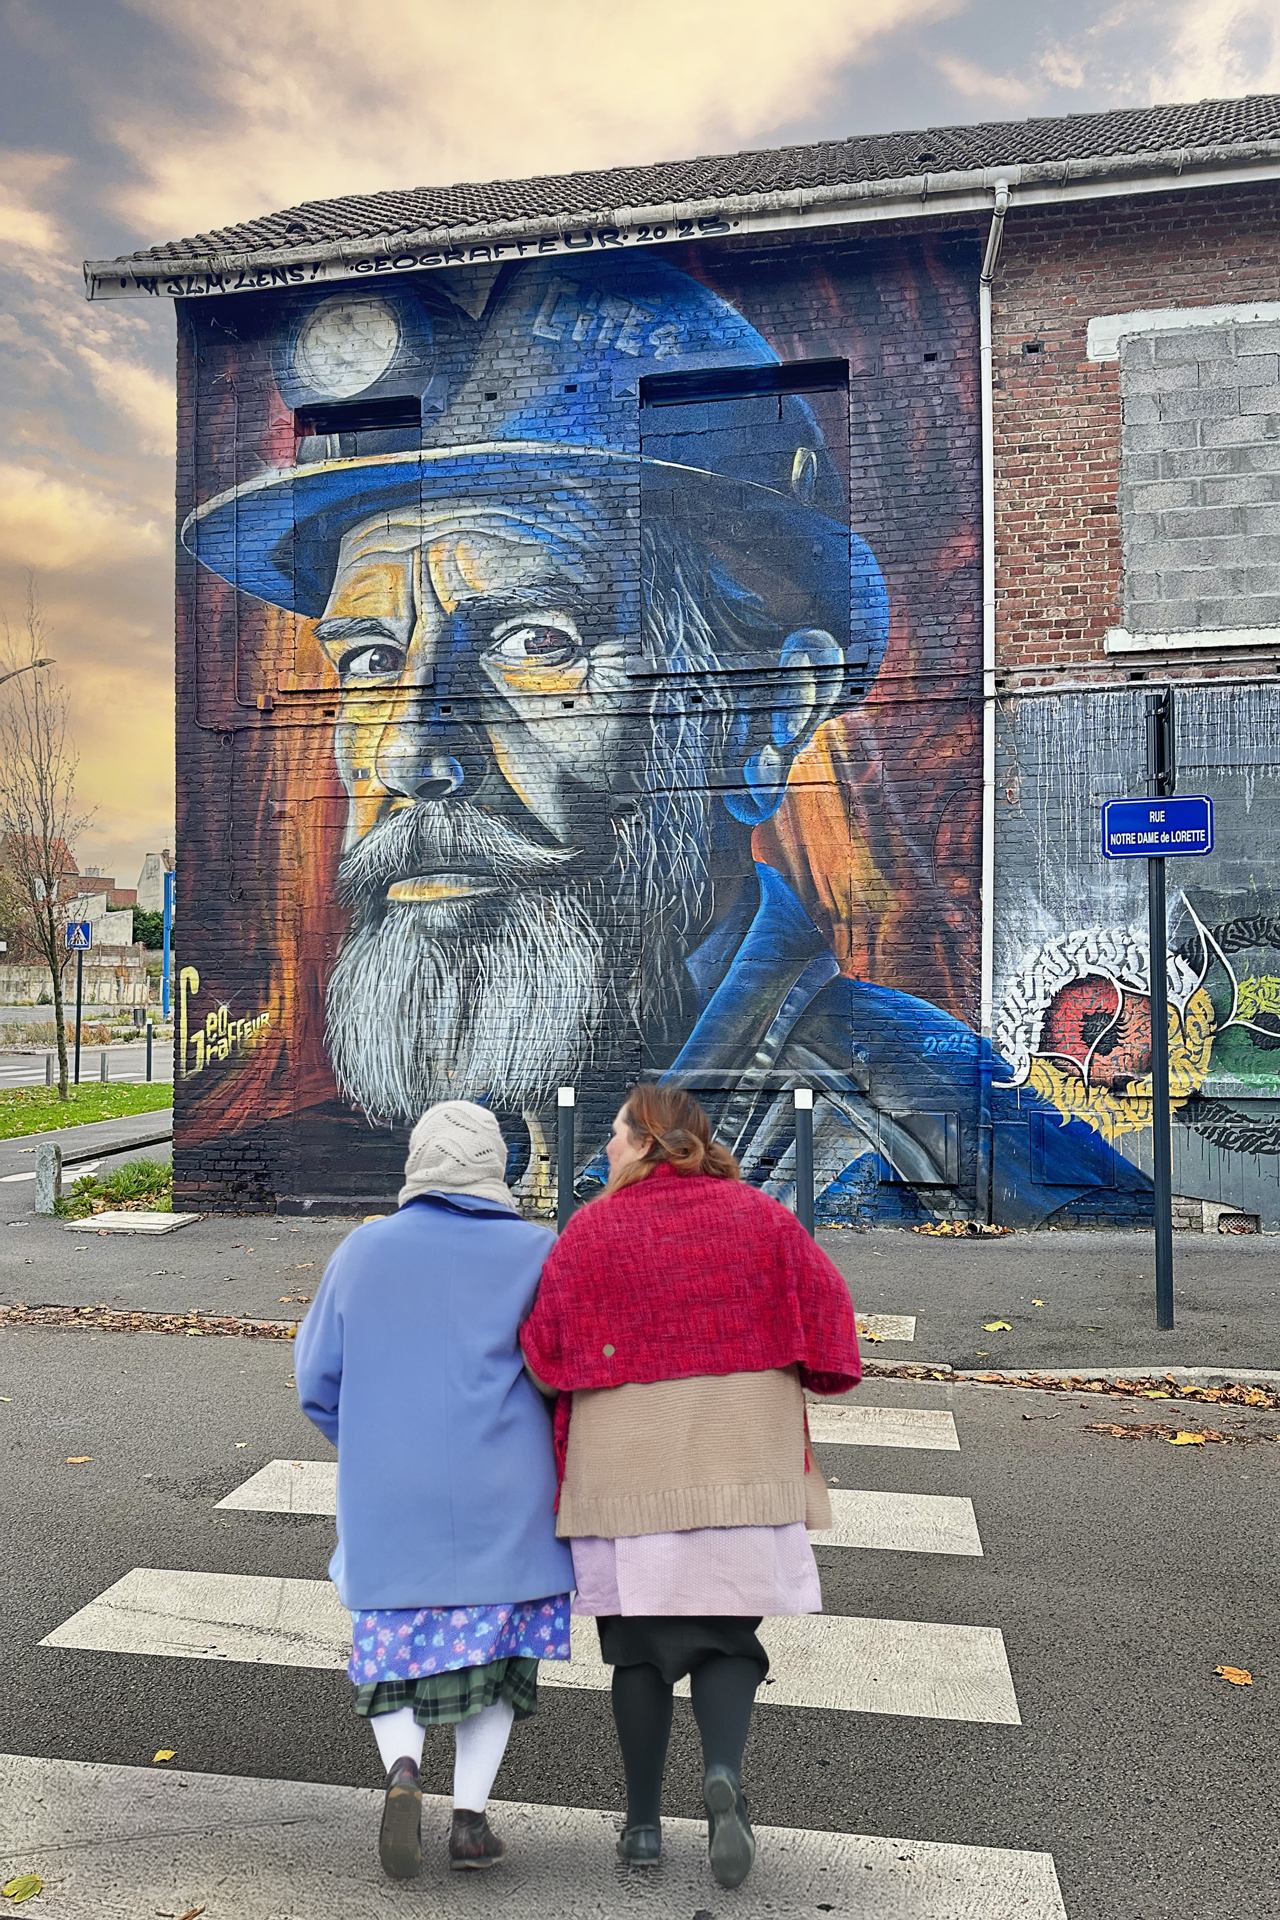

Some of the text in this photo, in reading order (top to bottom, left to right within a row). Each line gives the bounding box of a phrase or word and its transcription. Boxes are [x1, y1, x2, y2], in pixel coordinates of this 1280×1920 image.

[1149, 811, 1165, 822] RUE
[1110, 830, 1205, 845] NOTRE DAME de LORETTE
[922, 1033, 978, 1056] 2025
